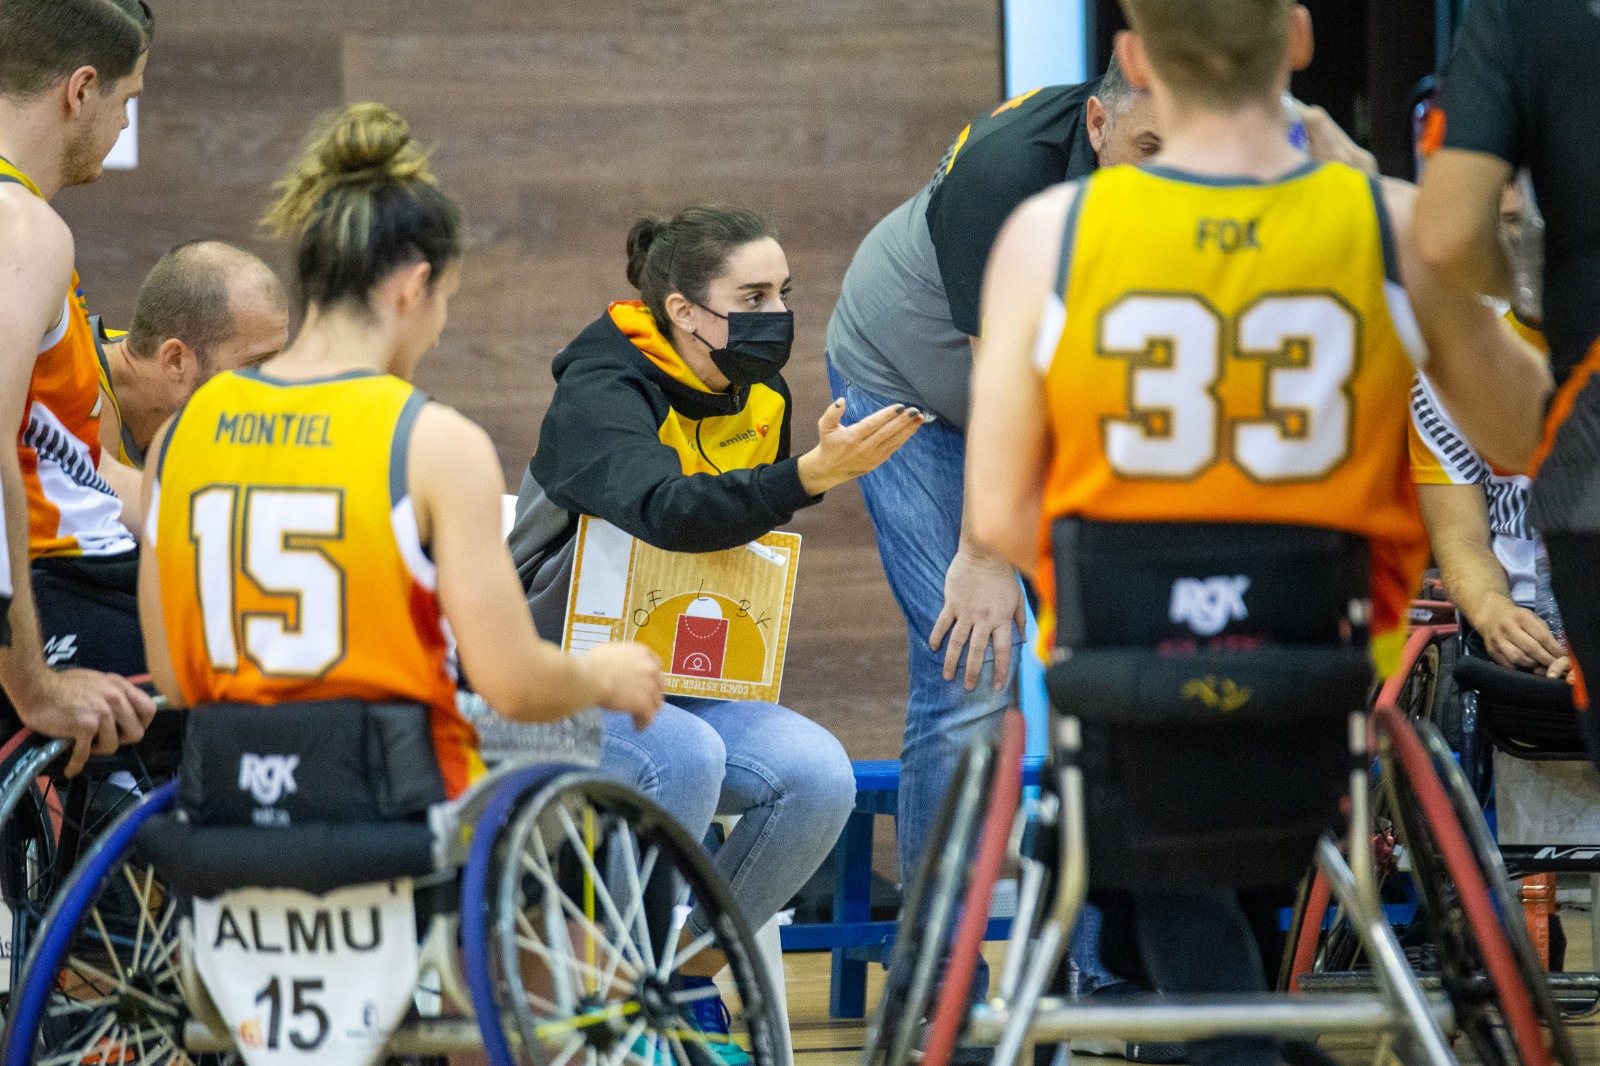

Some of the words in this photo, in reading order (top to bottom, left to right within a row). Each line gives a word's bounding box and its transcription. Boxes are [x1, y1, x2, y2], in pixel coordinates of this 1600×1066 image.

[1195, 216, 1262, 252] FOX
[1094, 288, 1364, 486] 33
[213, 411, 334, 447] MONTIEL
[188, 482, 348, 681] 15
[683, 679, 717, 692] ESTHER
[720, 683, 750, 695] COACH
[213, 905, 383, 954] ALMU
[254, 973, 331, 1051] 15
